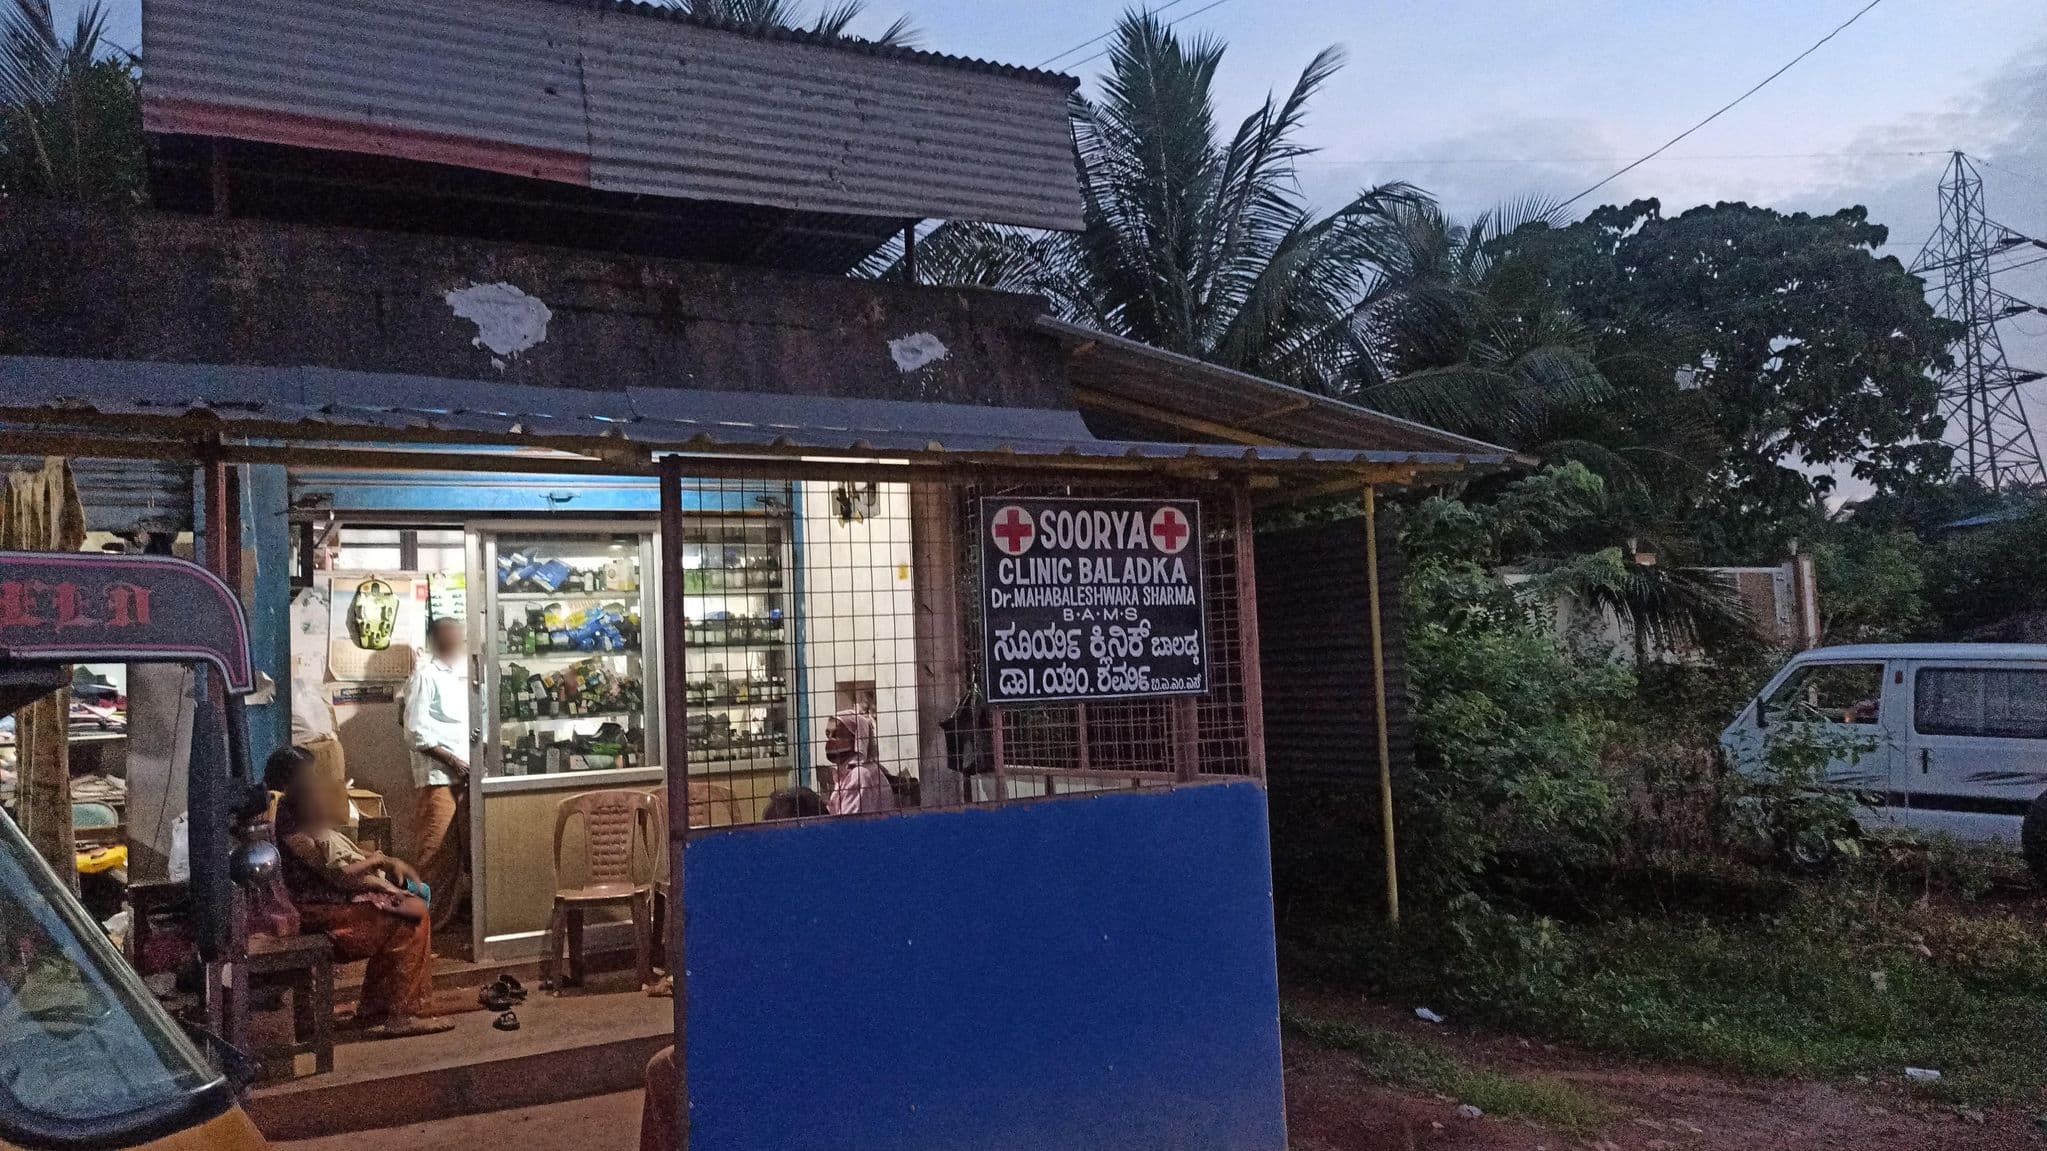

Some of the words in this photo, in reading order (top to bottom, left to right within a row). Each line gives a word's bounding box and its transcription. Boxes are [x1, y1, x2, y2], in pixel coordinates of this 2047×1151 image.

[1040, 510, 1149, 550] SOORYA
[999, 557, 1073, 585] CLINIC
[1079, 557, 1188, 584] BALADKA
[1143, 586, 1196, 606] SHARMA
[1090, 618, 1151, 665] ಕ್ಲಿನಿಕ್
